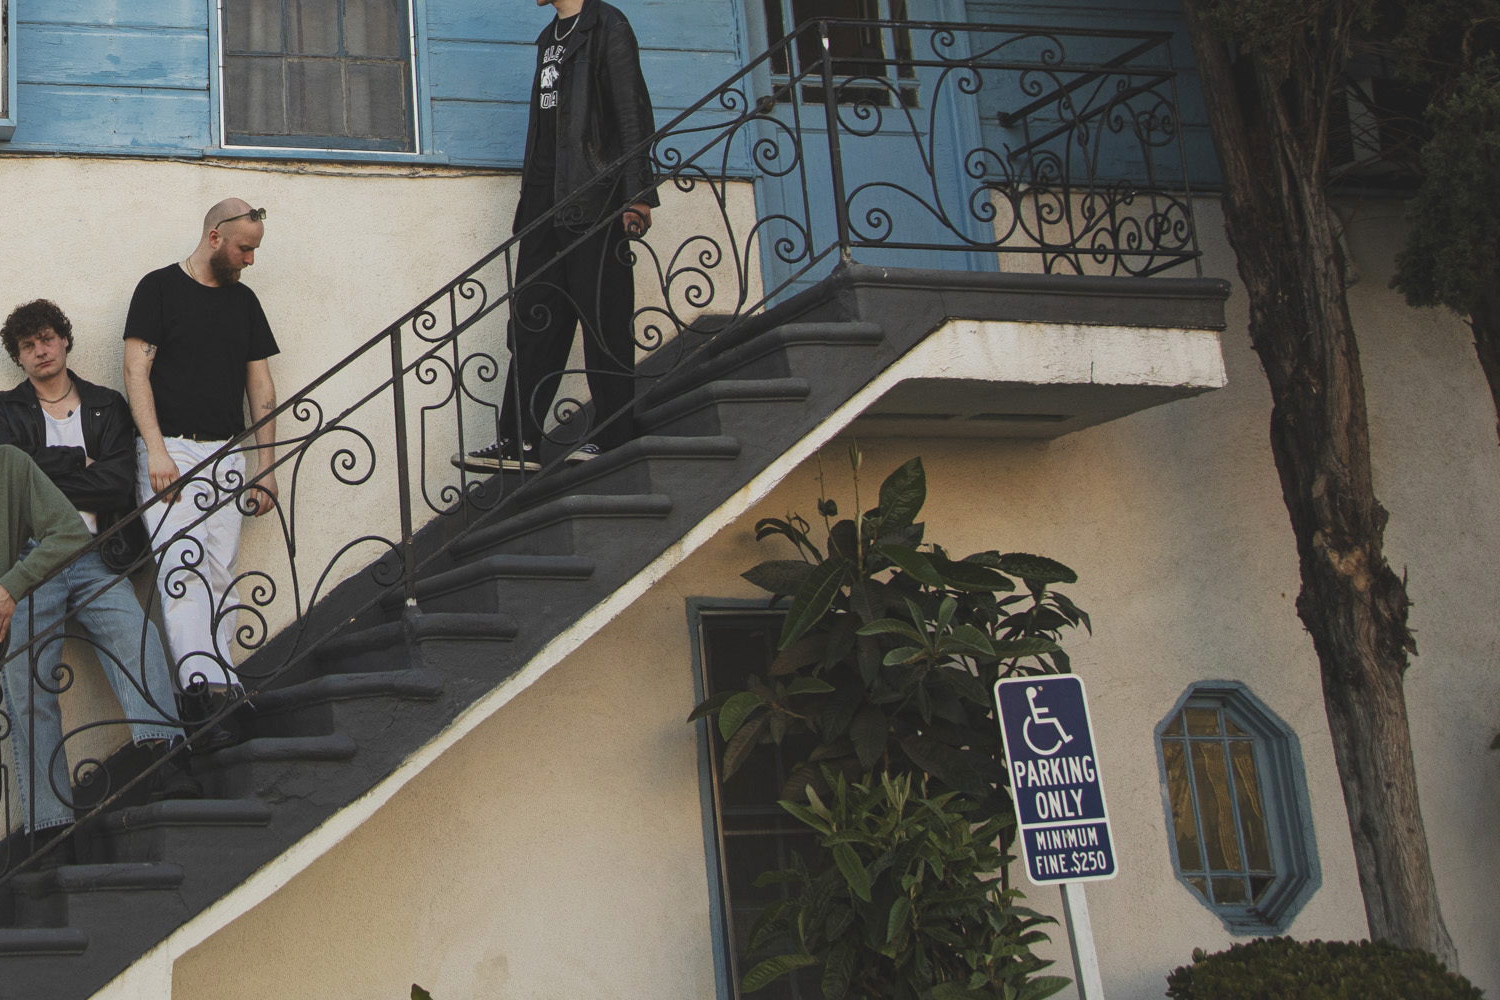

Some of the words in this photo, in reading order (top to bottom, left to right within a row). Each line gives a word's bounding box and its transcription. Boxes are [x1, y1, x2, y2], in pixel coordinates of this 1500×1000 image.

[1013, 755, 1096, 788] PARKING
[1035, 788, 1083, 819] ONLY
[1035, 826, 1099, 850] MINIMUM
